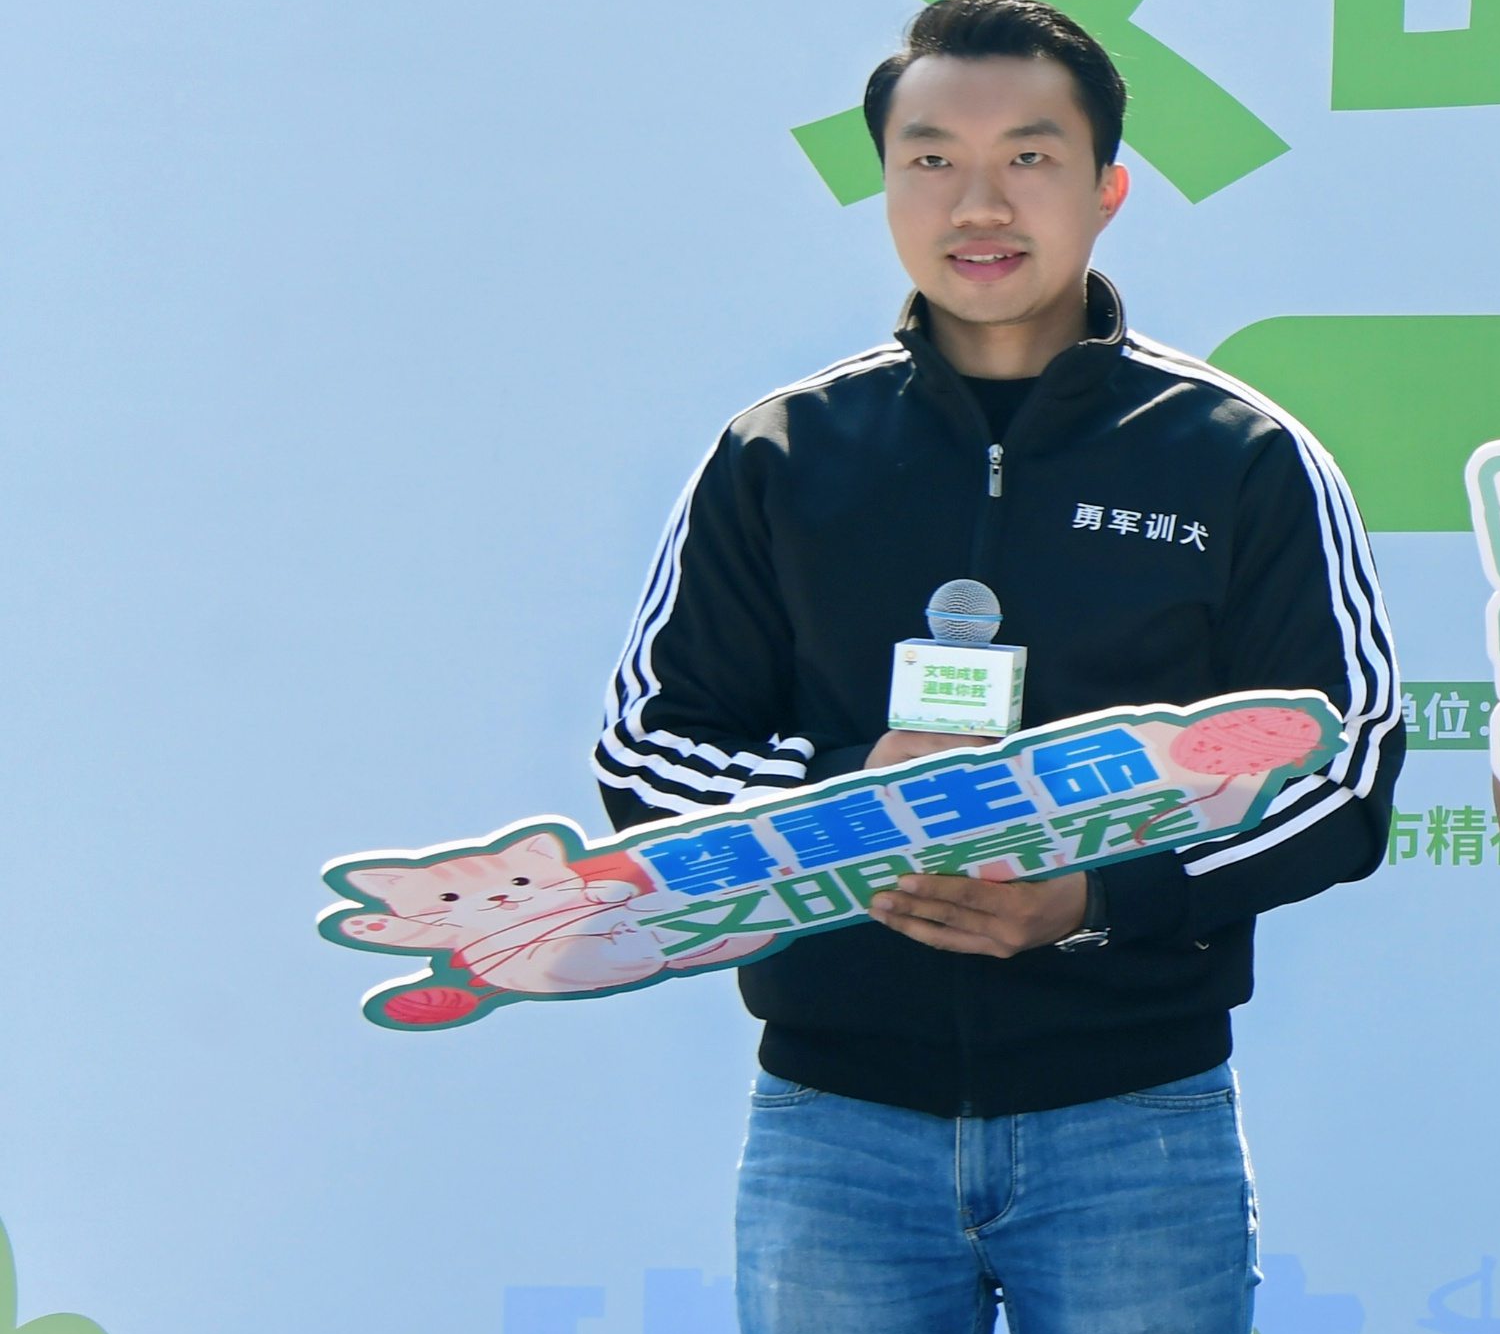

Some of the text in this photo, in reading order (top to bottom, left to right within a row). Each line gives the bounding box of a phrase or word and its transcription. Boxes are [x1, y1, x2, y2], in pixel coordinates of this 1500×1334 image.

[1072, 502, 1209, 552] 勇军训犬
[637, 788, 1201, 958] 文明养宠
[640, 727, 1161, 897] 尊重生命
